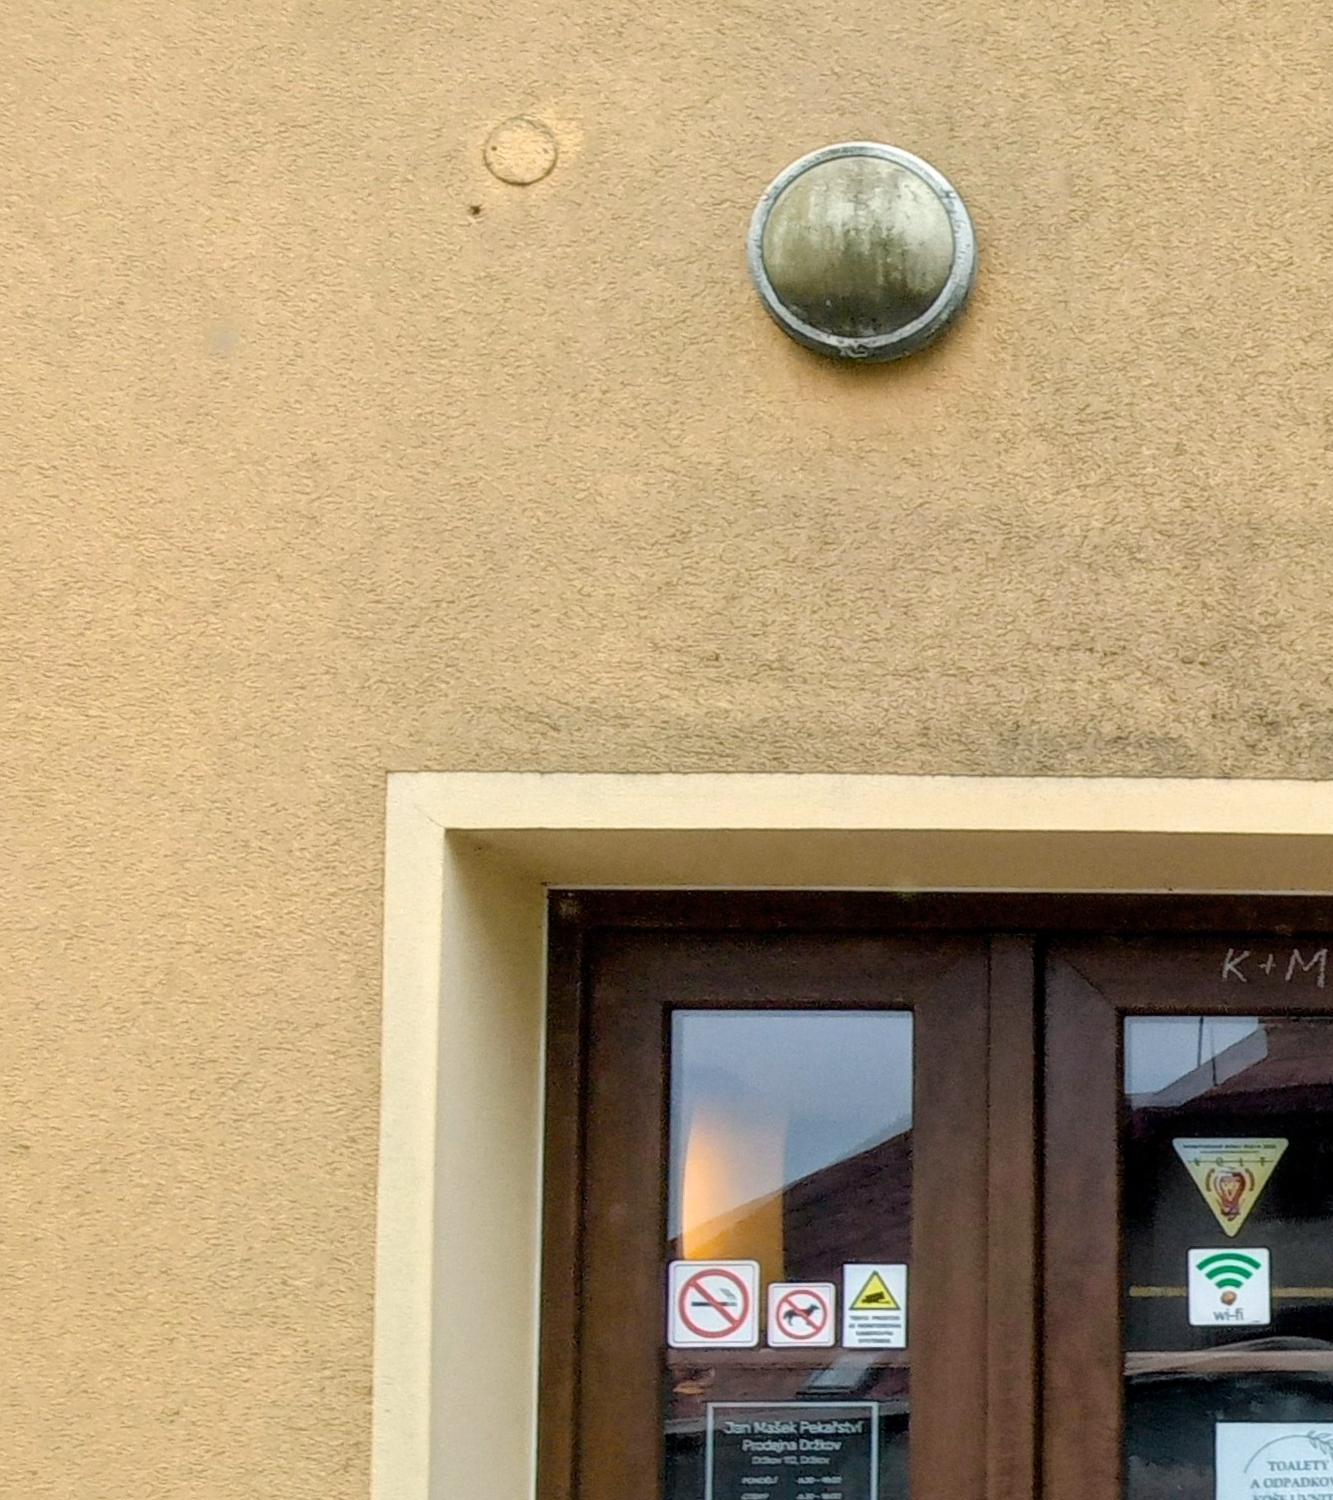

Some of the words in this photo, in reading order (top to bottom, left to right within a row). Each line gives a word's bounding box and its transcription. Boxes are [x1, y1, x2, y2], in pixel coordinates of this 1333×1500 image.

[1213, 1308, 1244, 1321] wi-fi
[742, 1439, 798, 1453] Prodejna
[1267, 1460, 1329, 1472] TOALETY
[1250, 1478, 1260, 1489] A
